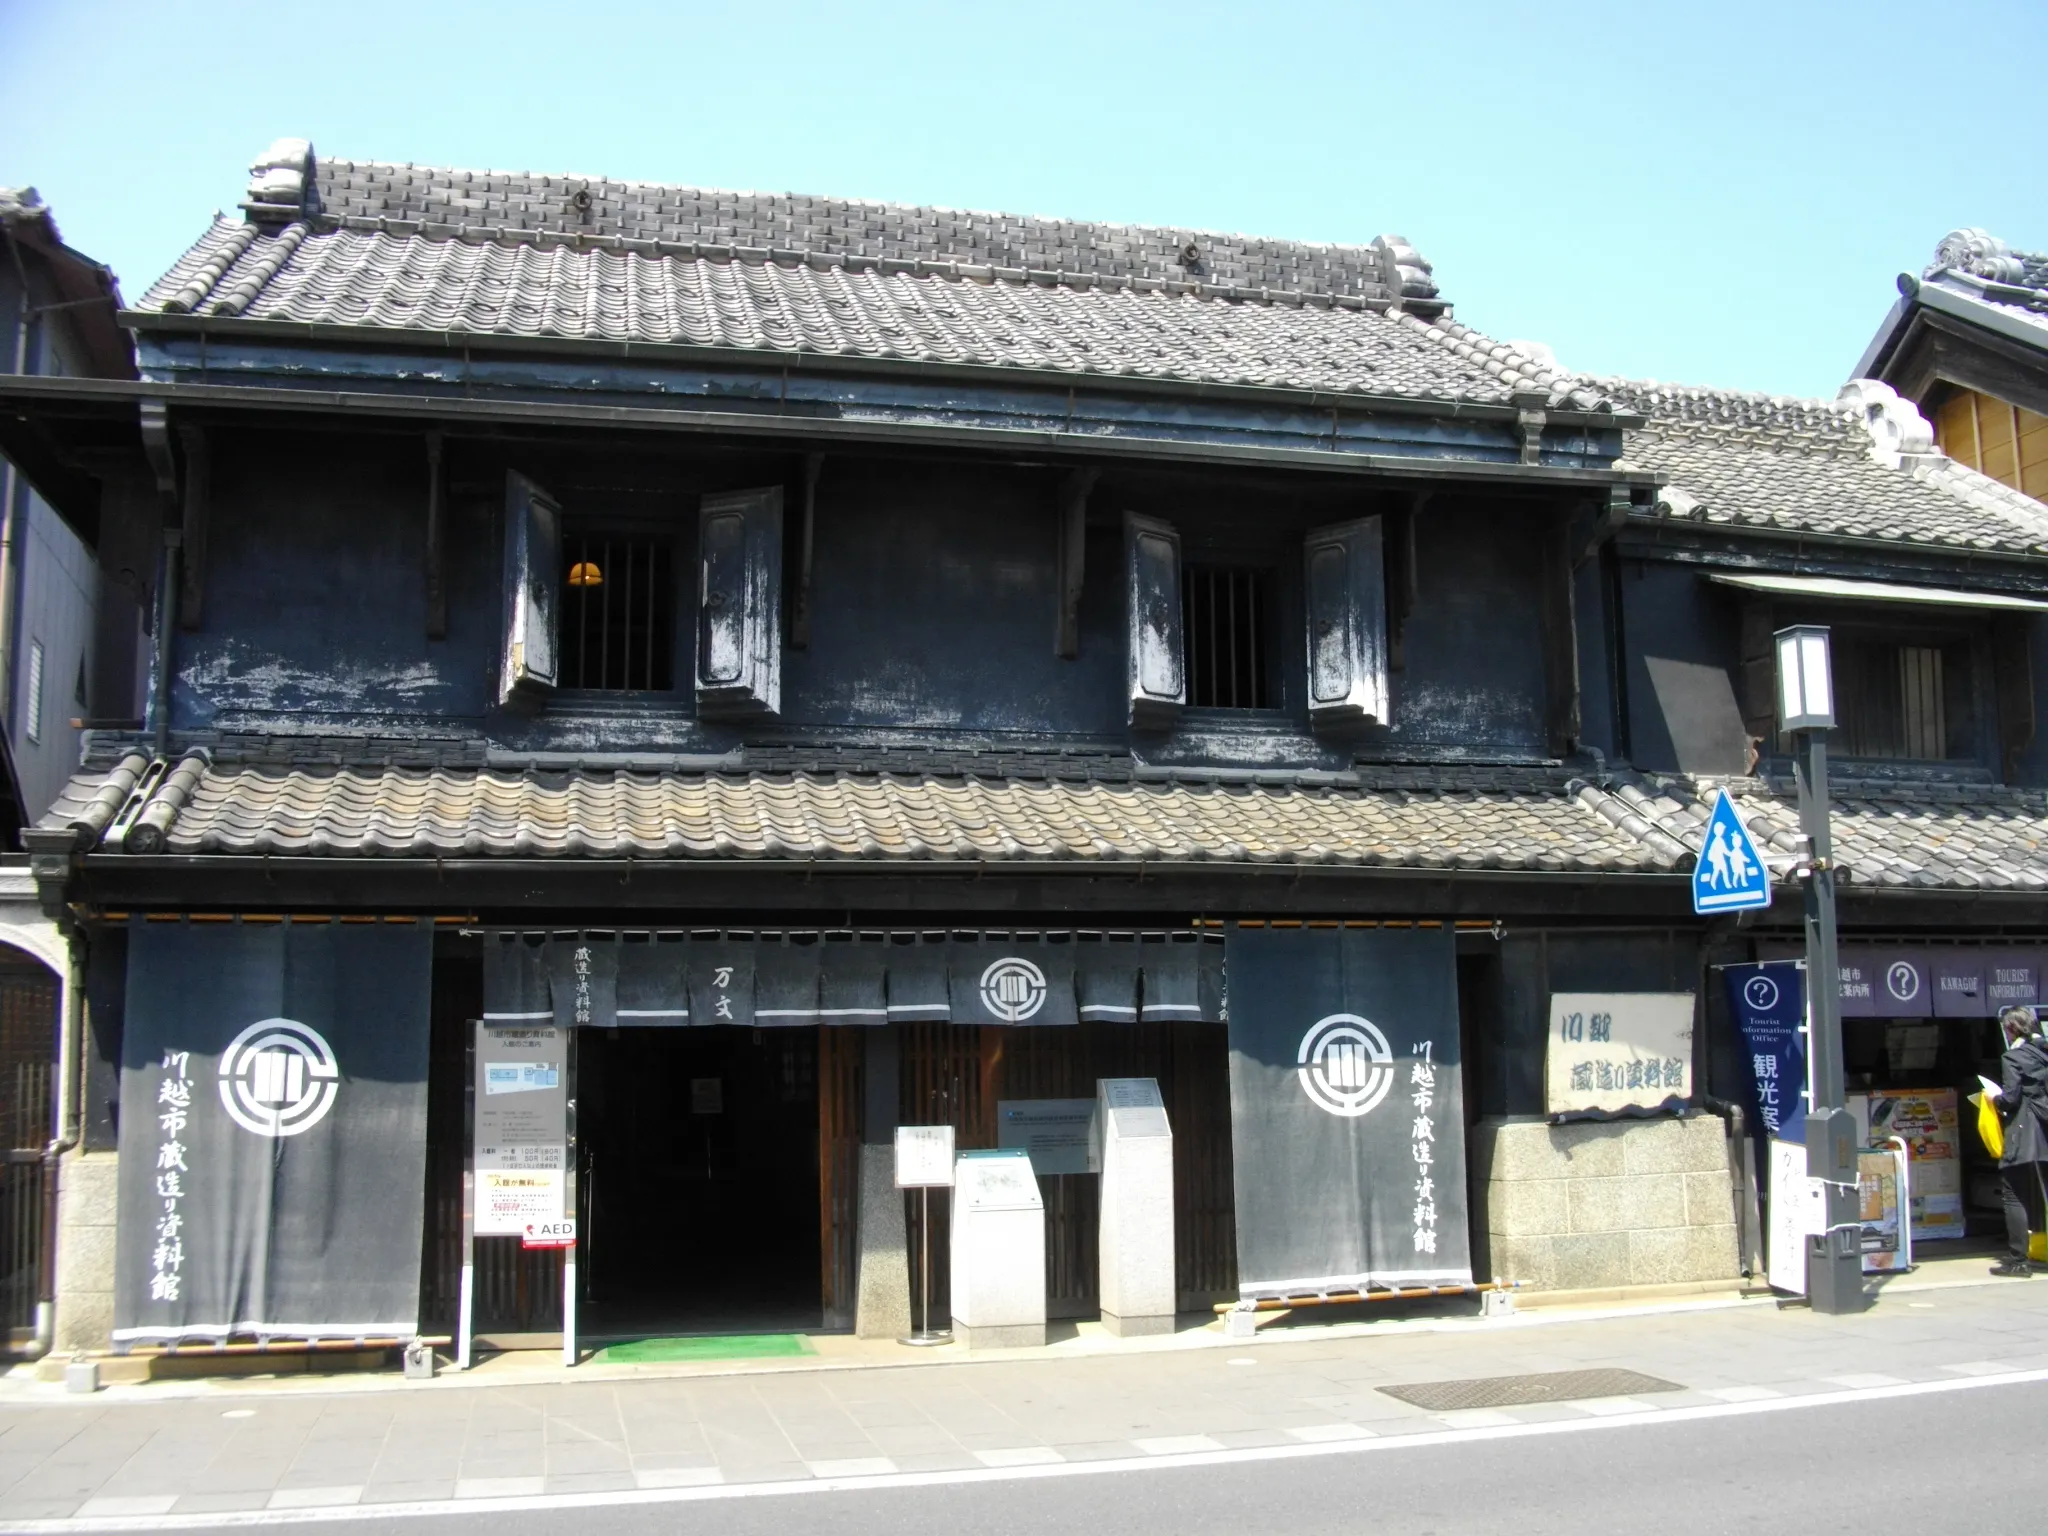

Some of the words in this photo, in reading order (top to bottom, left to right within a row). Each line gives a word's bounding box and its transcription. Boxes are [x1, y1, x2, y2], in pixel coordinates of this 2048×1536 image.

[1996, 968, 2031, 982] TOURIST
[574, 946, 592, 1023] 蔵造り資料館
[1989, 984, 2036, 998] INFORMATION
[712, 966, 735, 1022] 万文
[1749, 1017, 1780, 1026] Tourist
[1741, 1025, 1792, 1035] nformation
[1752, 1034, 1779, 1042] Office
[1410, 1040, 1438, 1254] 川越市蔵造り資料館
[151, 1051, 194, 1301] 川越市蔵造り資料館
[541, 1224, 573, 1235] AED
